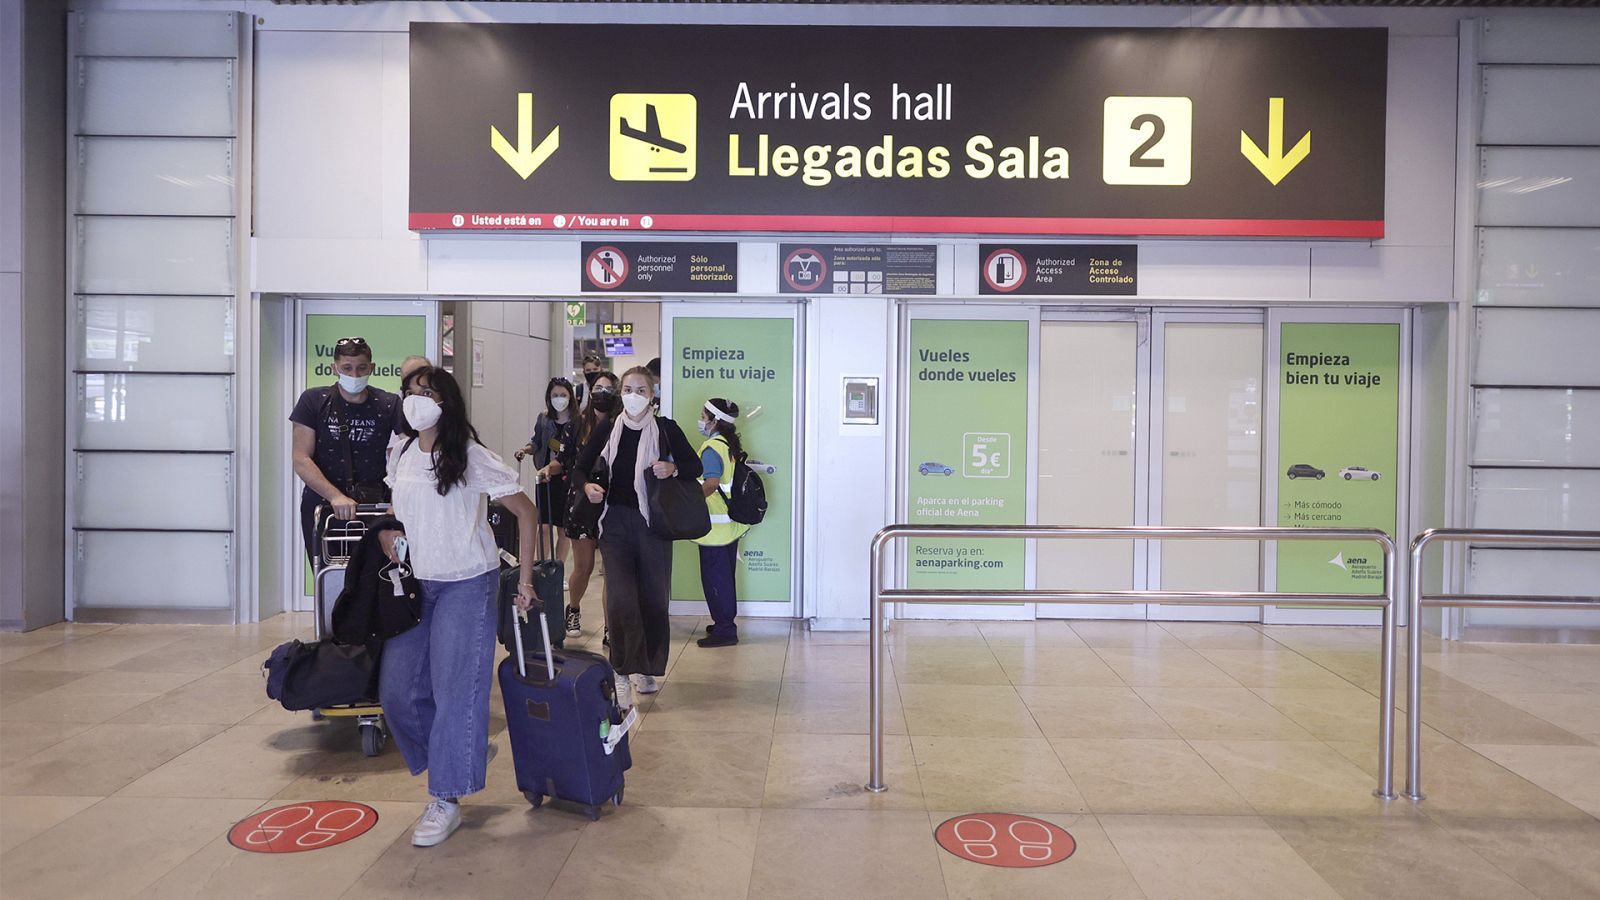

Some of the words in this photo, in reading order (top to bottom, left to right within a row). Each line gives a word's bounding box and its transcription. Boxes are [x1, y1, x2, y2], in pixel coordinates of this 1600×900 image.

[730, 82, 871, 120] Arrivals
[892, 83, 951, 120] hall
[729, 134, 950, 186] Llegadas
[965, 135, 1069, 179] Sala
[1130, 114, 1165, 167] 2
[472, 215, 501, 225] Usted
[504, 215, 526, 225] está
[578, 216, 598, 225] You
[600, 218, 617, 226] are
[620, 216, 629, 226] in
[691, 255, 708, 263] Sólo
[638, 273, 652, 281] only
[1090, 275, 1133, 283] Controlado
[622, 324, 631, 332] 12
[683, 347, 744, 362] Empieza
[919, 349, 969, 362] Vueles
[1287, 352, 1349, 368] Empieza
[372, 364, 400, 376] uele
[683, 366, 714, 378] bien
[719, 367, 734, 379] tu
[740, 366, 776, 382] viaje
[919, 368, 964, 381] donde
[968, 369, 1016, 382] vueles
[1287, 371, 1318, 384] bien
[1324, 373, 1339, 384] tu
[1344, 372, 1380, 388] viaje
[917, 497, 946, 506] Aparca
[948, 497, 960, 505] en
[961, 497, 969, 506] el
[972, 497, 1004, 507] parking
[1294, 500, 1310, 508] Más
[1312, 500, 1342, 508] cómodo
[917, 508, 942, 516] oficial
[944, 508, 955, 516] de
[957, 509, 979, 517] Aena
[1294, 512, 1310, 520] Más
[916, 546, 953, 556] Reserva
[956, 548, 967, 556] ya
[916, 558, 1003, 569] aenaparking.com
